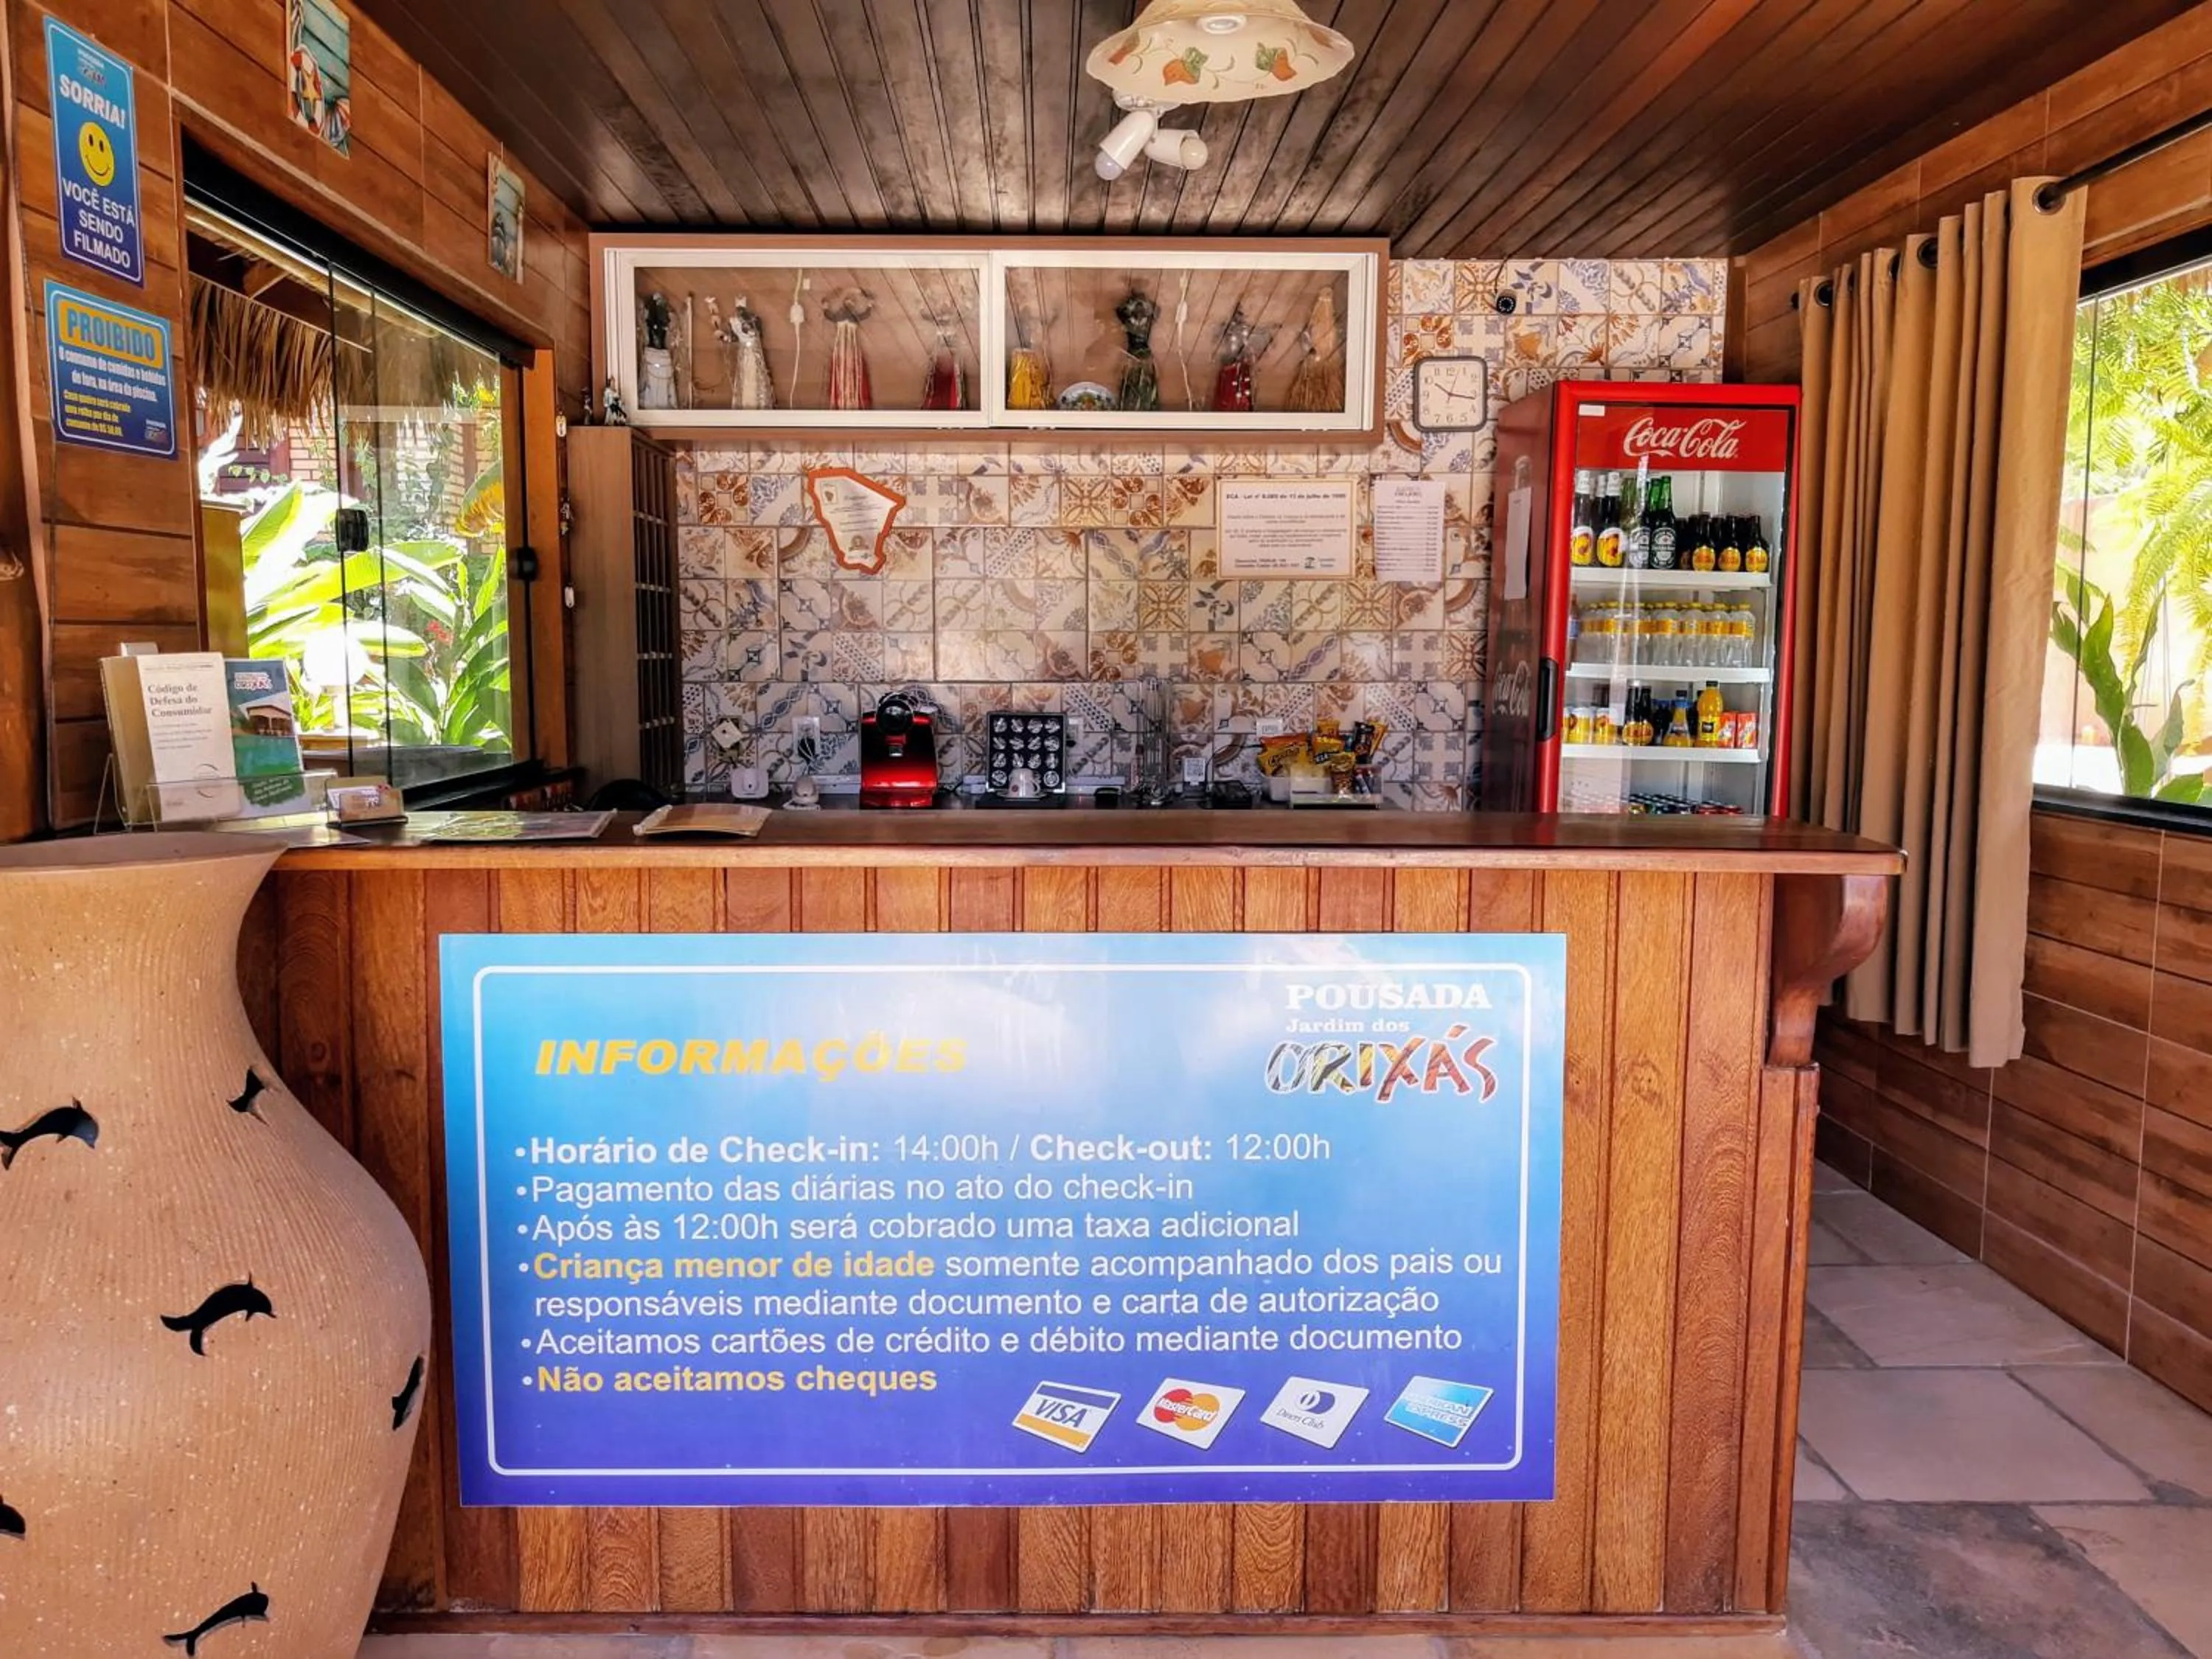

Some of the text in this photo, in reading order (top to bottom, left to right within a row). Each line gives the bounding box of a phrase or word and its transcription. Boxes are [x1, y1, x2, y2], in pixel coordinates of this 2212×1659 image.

[59, 74, 125, 129] SORRIA!
[62, 177, 135, 227] VOCÊ ESTÁ
[79, 209, 123, 243] SENDO
[74, 232, 131, 268] FILMADO
[66, 305, 156, 361] PROIBIDO
[1622, 417, 1746, 459] Coca-Cola
[147, 683, 198, 695] Código de
[149, 695, 183, 706] Defesa
[1285, 983, 1492, 1010] POUSADA
[1286, 1018, 1410, 1034] Jardim dos
[535, 1030, 967, 1082] INFORMAÇÕES
[1264, 1023, 1499, 1105] ORIXÁS
[530, 1136, 657, 1164] Horário
[668, 1136, 708, 1163] de
[720, 1136, 878, 1163] Check-in:
[895, 1135, 997, 1161] 14:00h
[1031, 1135, 1210, 1160] Check-out:
[1227, 1134, 1329, 1160] 12:00h
[532, 1174, 1192, 1208] Pagamento das diárias no ato do check-in
[532, 1210, 1298, 1248] Após às 12:00h será cobrado uma taxa adicional
[533, 1248, 1501, 1287] Criança menor de idade somente acompanhado dos pais ou
[535, 1286, 1439, 1322] responsáveis mediante documento e carta de autorização
[536, 1324, 1462, 1354] Aceitamos cartões de crédito e débito mediante documento
[537, 1365, 938, 1397] Não aceitamos cheques
[1034, 1399, 1088, 1428] VISA
[1158, 1397, 1217, 1422] MasterCard
[1301, 1415, 1325, 1430] Club
